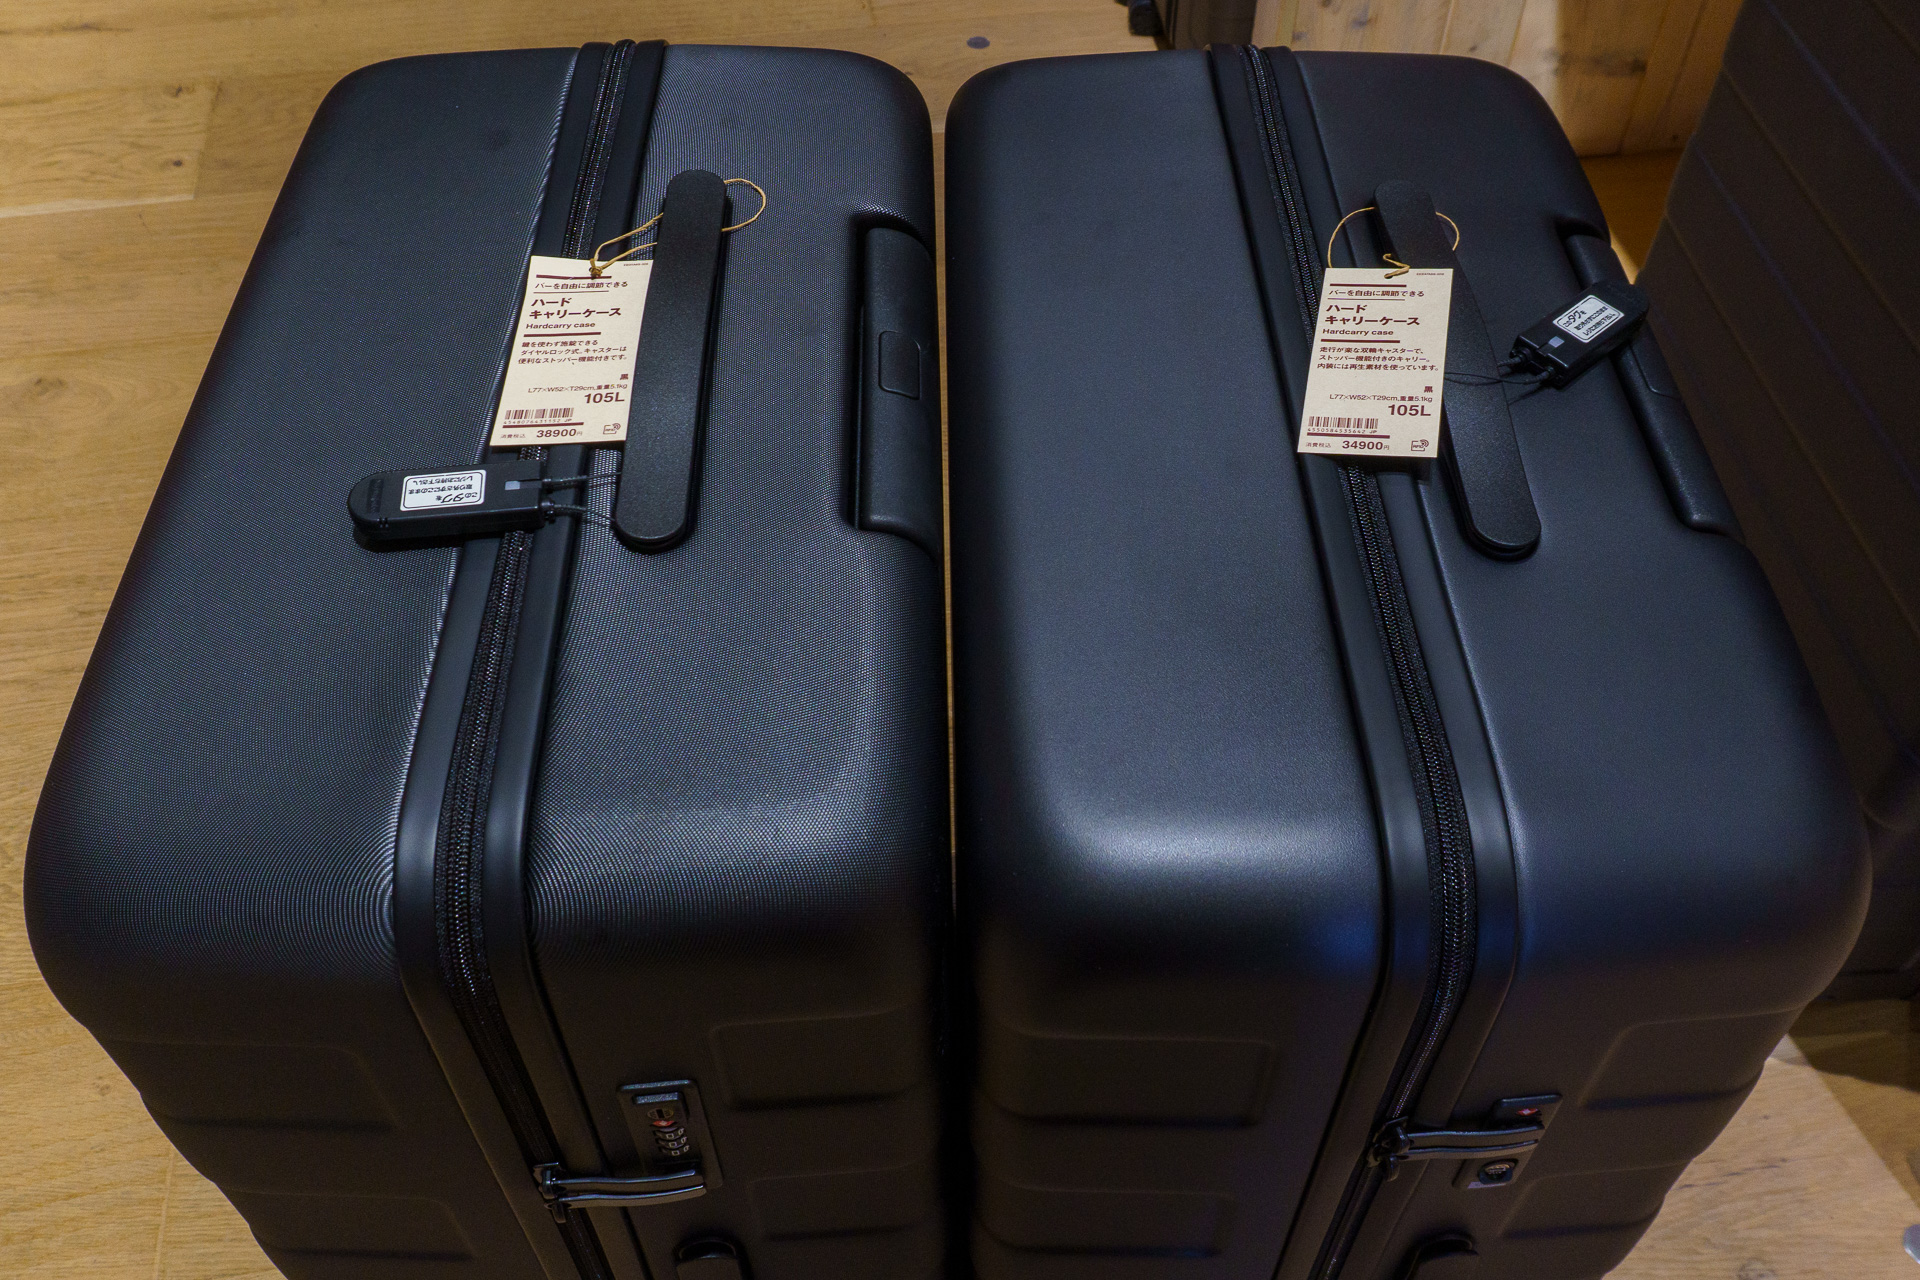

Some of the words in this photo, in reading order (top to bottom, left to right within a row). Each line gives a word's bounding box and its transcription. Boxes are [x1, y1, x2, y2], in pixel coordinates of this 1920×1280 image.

[535, 281, 628, 289] バーを自由に調節できる
[531, 298, 572, 306] ハード
[1326, 304, 1367, 313] ハード
[529, 308, 621, 319] キャリーケース
[1325, 316, 1420, 325] キャリーケース
[522, 340, 598, 348] 鍵を使わず施錠できる
[518, 354, 627, 364] 便利なストッパー機能付きです。
[1317, 363, 1438, 371] 内装には再生素材を使っています。
[584, 392, 625, 404] 105L
[1388, 404, 1431, 416] 105L
